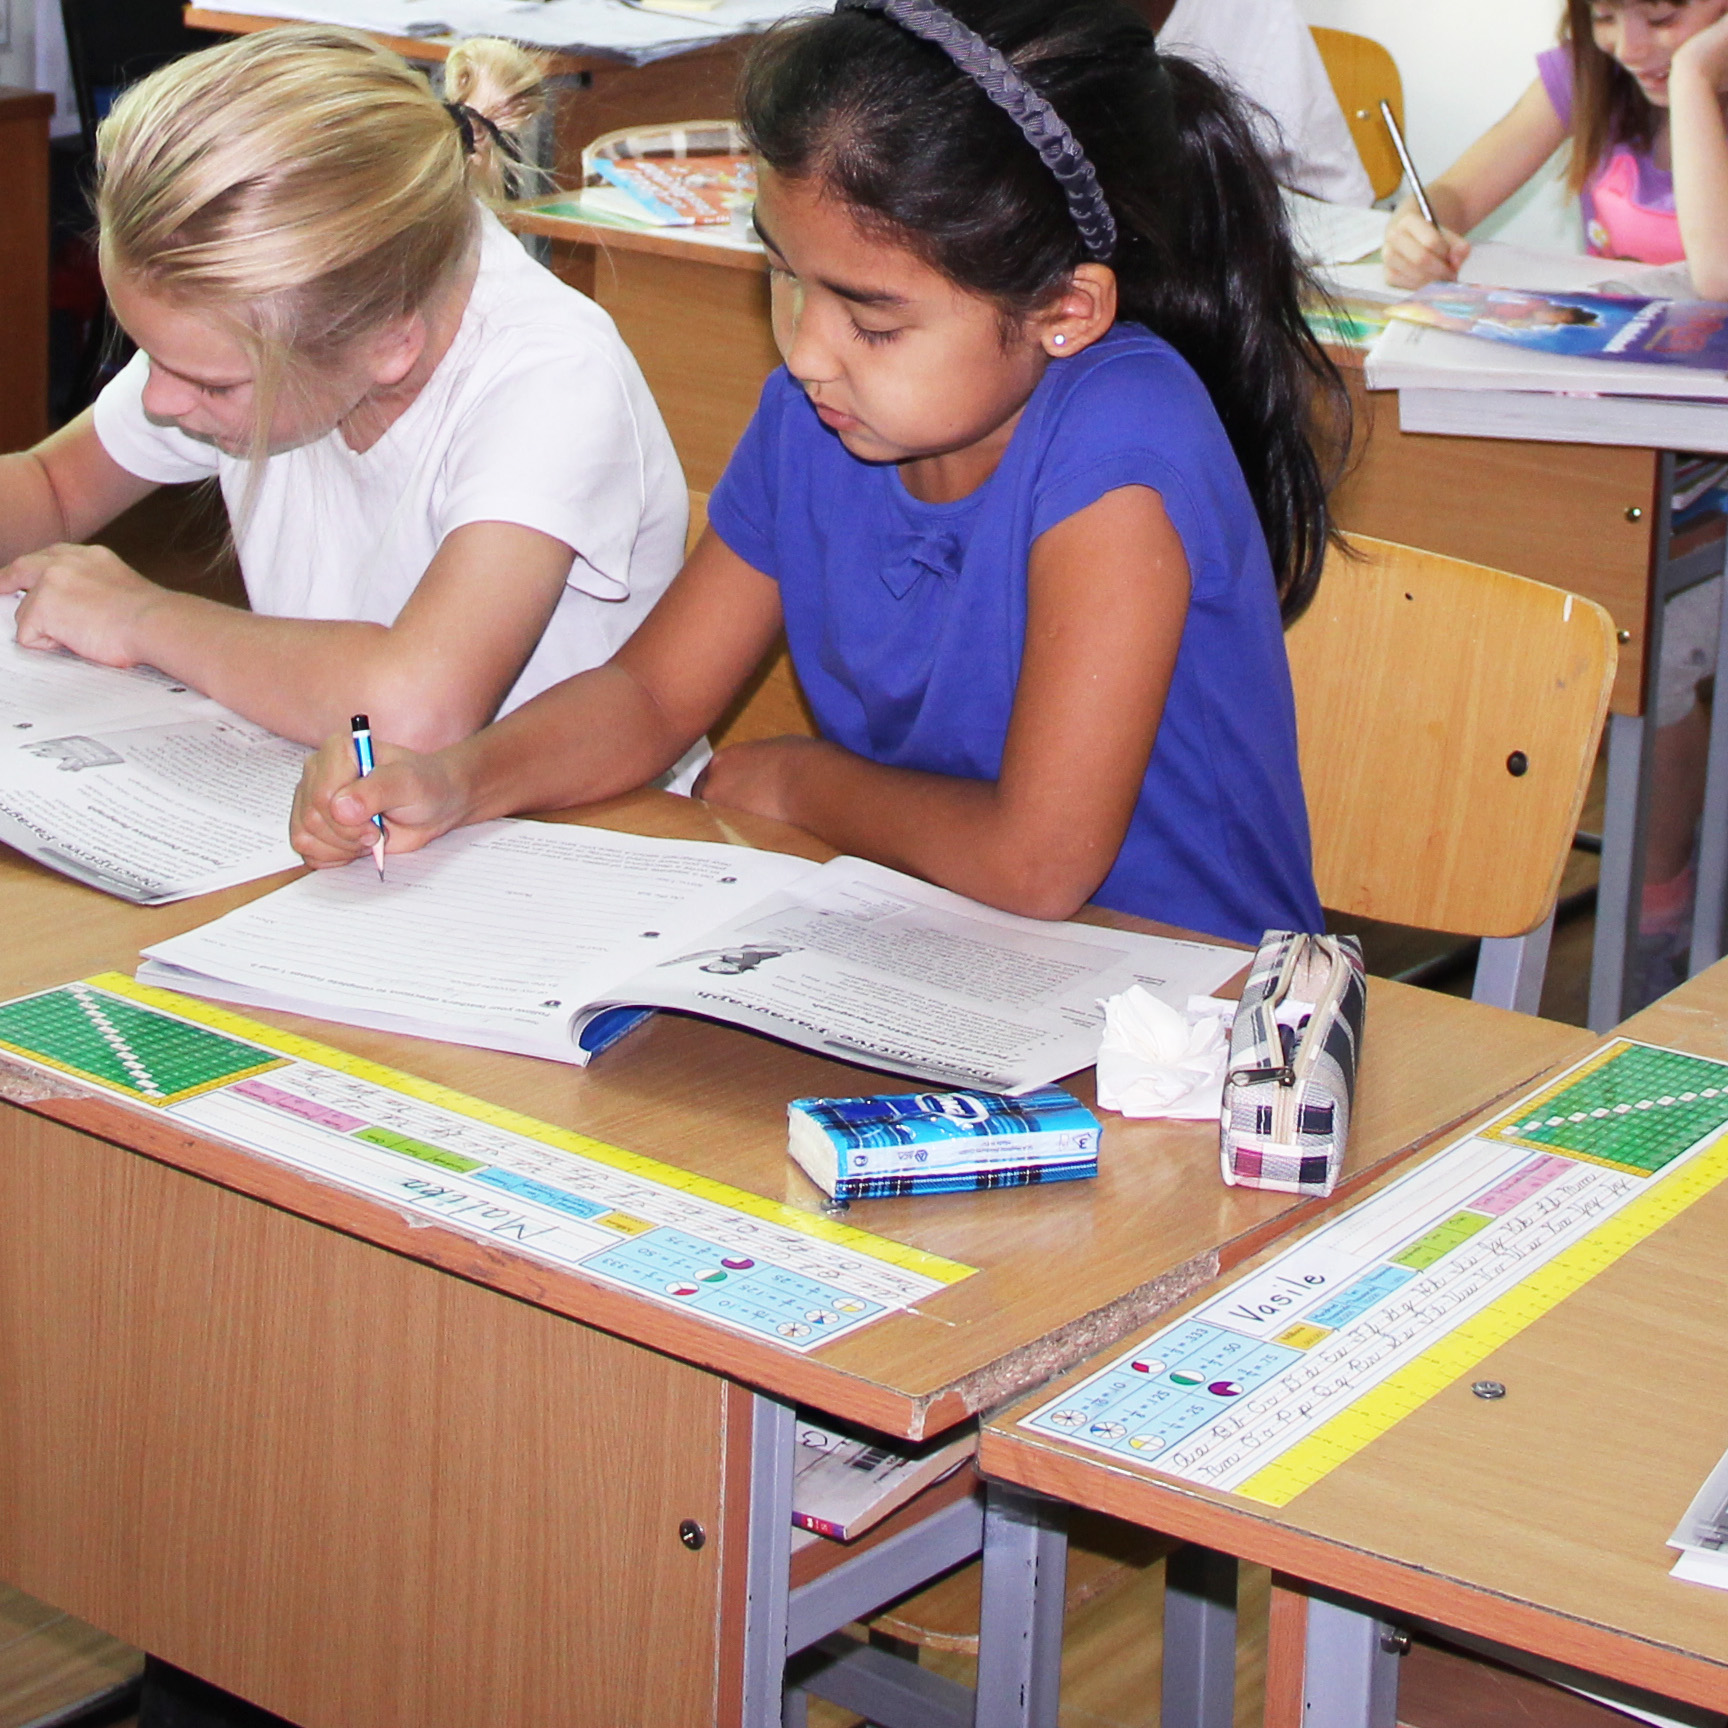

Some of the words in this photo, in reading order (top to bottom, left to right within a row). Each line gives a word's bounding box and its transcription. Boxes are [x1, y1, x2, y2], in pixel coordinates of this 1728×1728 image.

[57, 841, 160, 889] Descriptive
[690, 989, 832, 1038] Paragraph
[833, 1032, 995, 1081] Descriptive
[401, 1178, 561, 1241] Malika
[1228, 1273, 1326, 1323] Vasile
